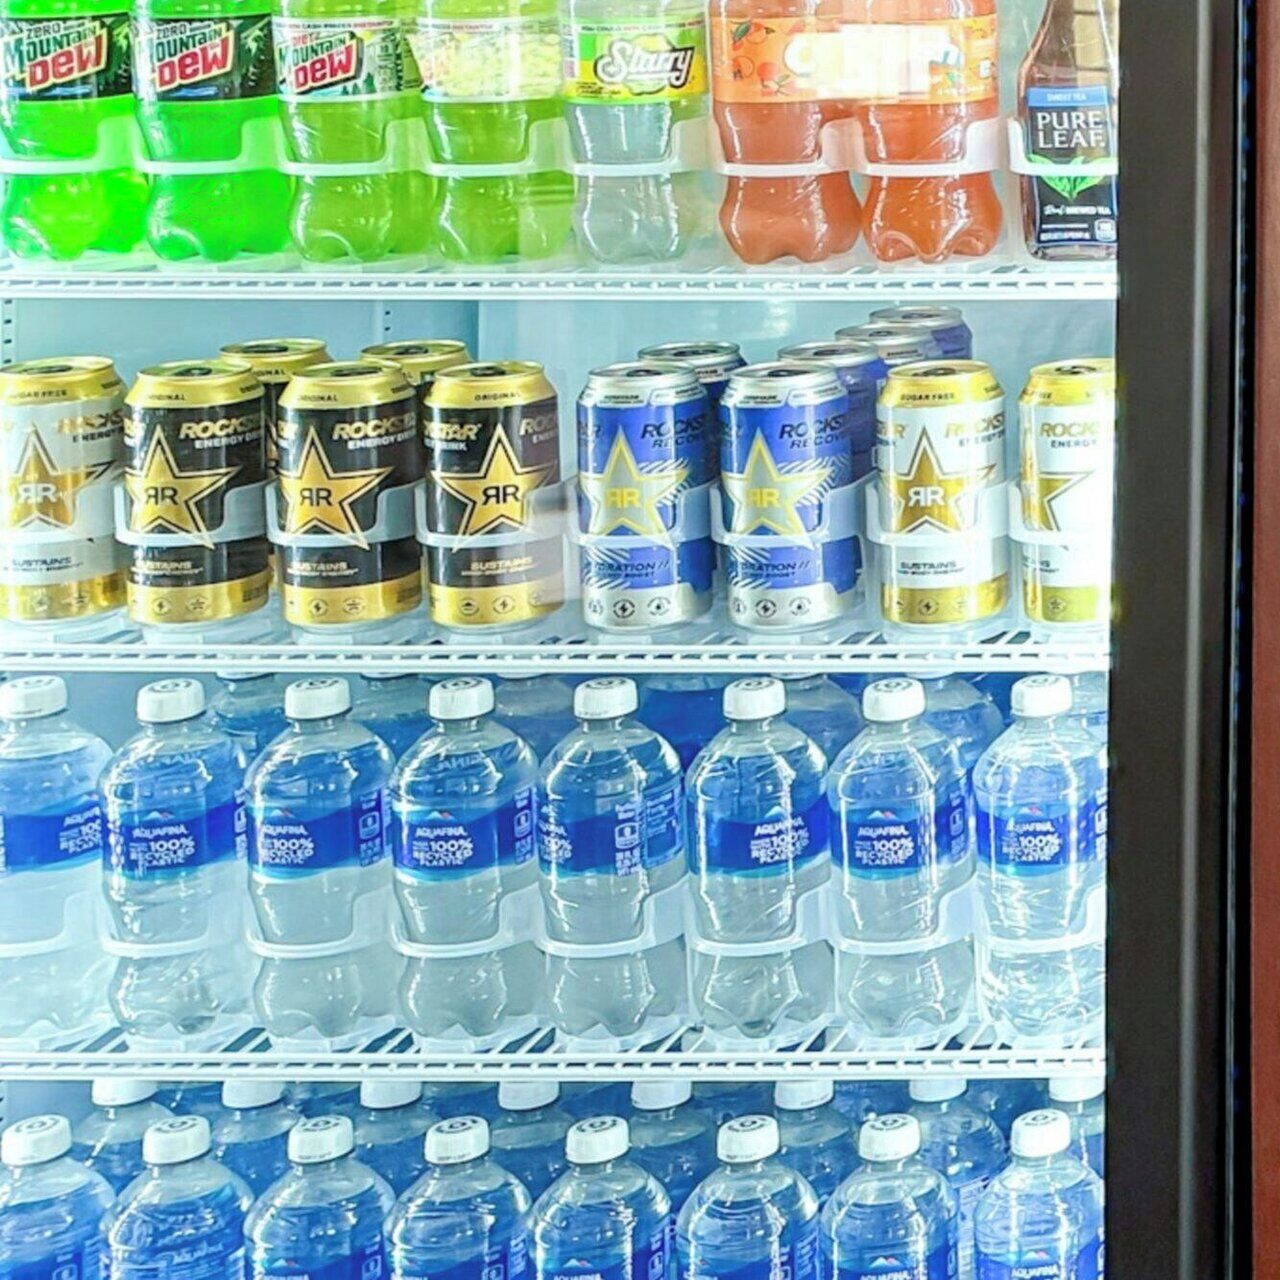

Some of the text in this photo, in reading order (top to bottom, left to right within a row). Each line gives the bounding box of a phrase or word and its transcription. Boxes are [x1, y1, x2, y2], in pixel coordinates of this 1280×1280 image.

[28, 33, 104, 89] DeW
[157, 36, 231, 88] DeW
[293, 44, 355, 90] DeW
[1036, 111, 1103, 130] PURE
[1038, 130, 1105, 149] LEAF
[474, 391, 522, 403] ORIGINAL
[195, 433, 244, 450] ENERGY
[347, 434, 396, 451] ENERGY
[132, 824, 188, 839] AQUAFINA
[415, 825, 468, 838] AQUAFINA
[857, 824, 910, 838] AQUAFINA
[149, 836, 195, 851] 100%
[272, 838, 314, 851] 100%
[429, 838, 474, 851] 100%
[873, 837, 915, 851] 100%
[1018, 834, 1062, 847] 100%
[413, 848, 473, 860] RECYCLED
[855, 847, 915, 860] RECYCLED
